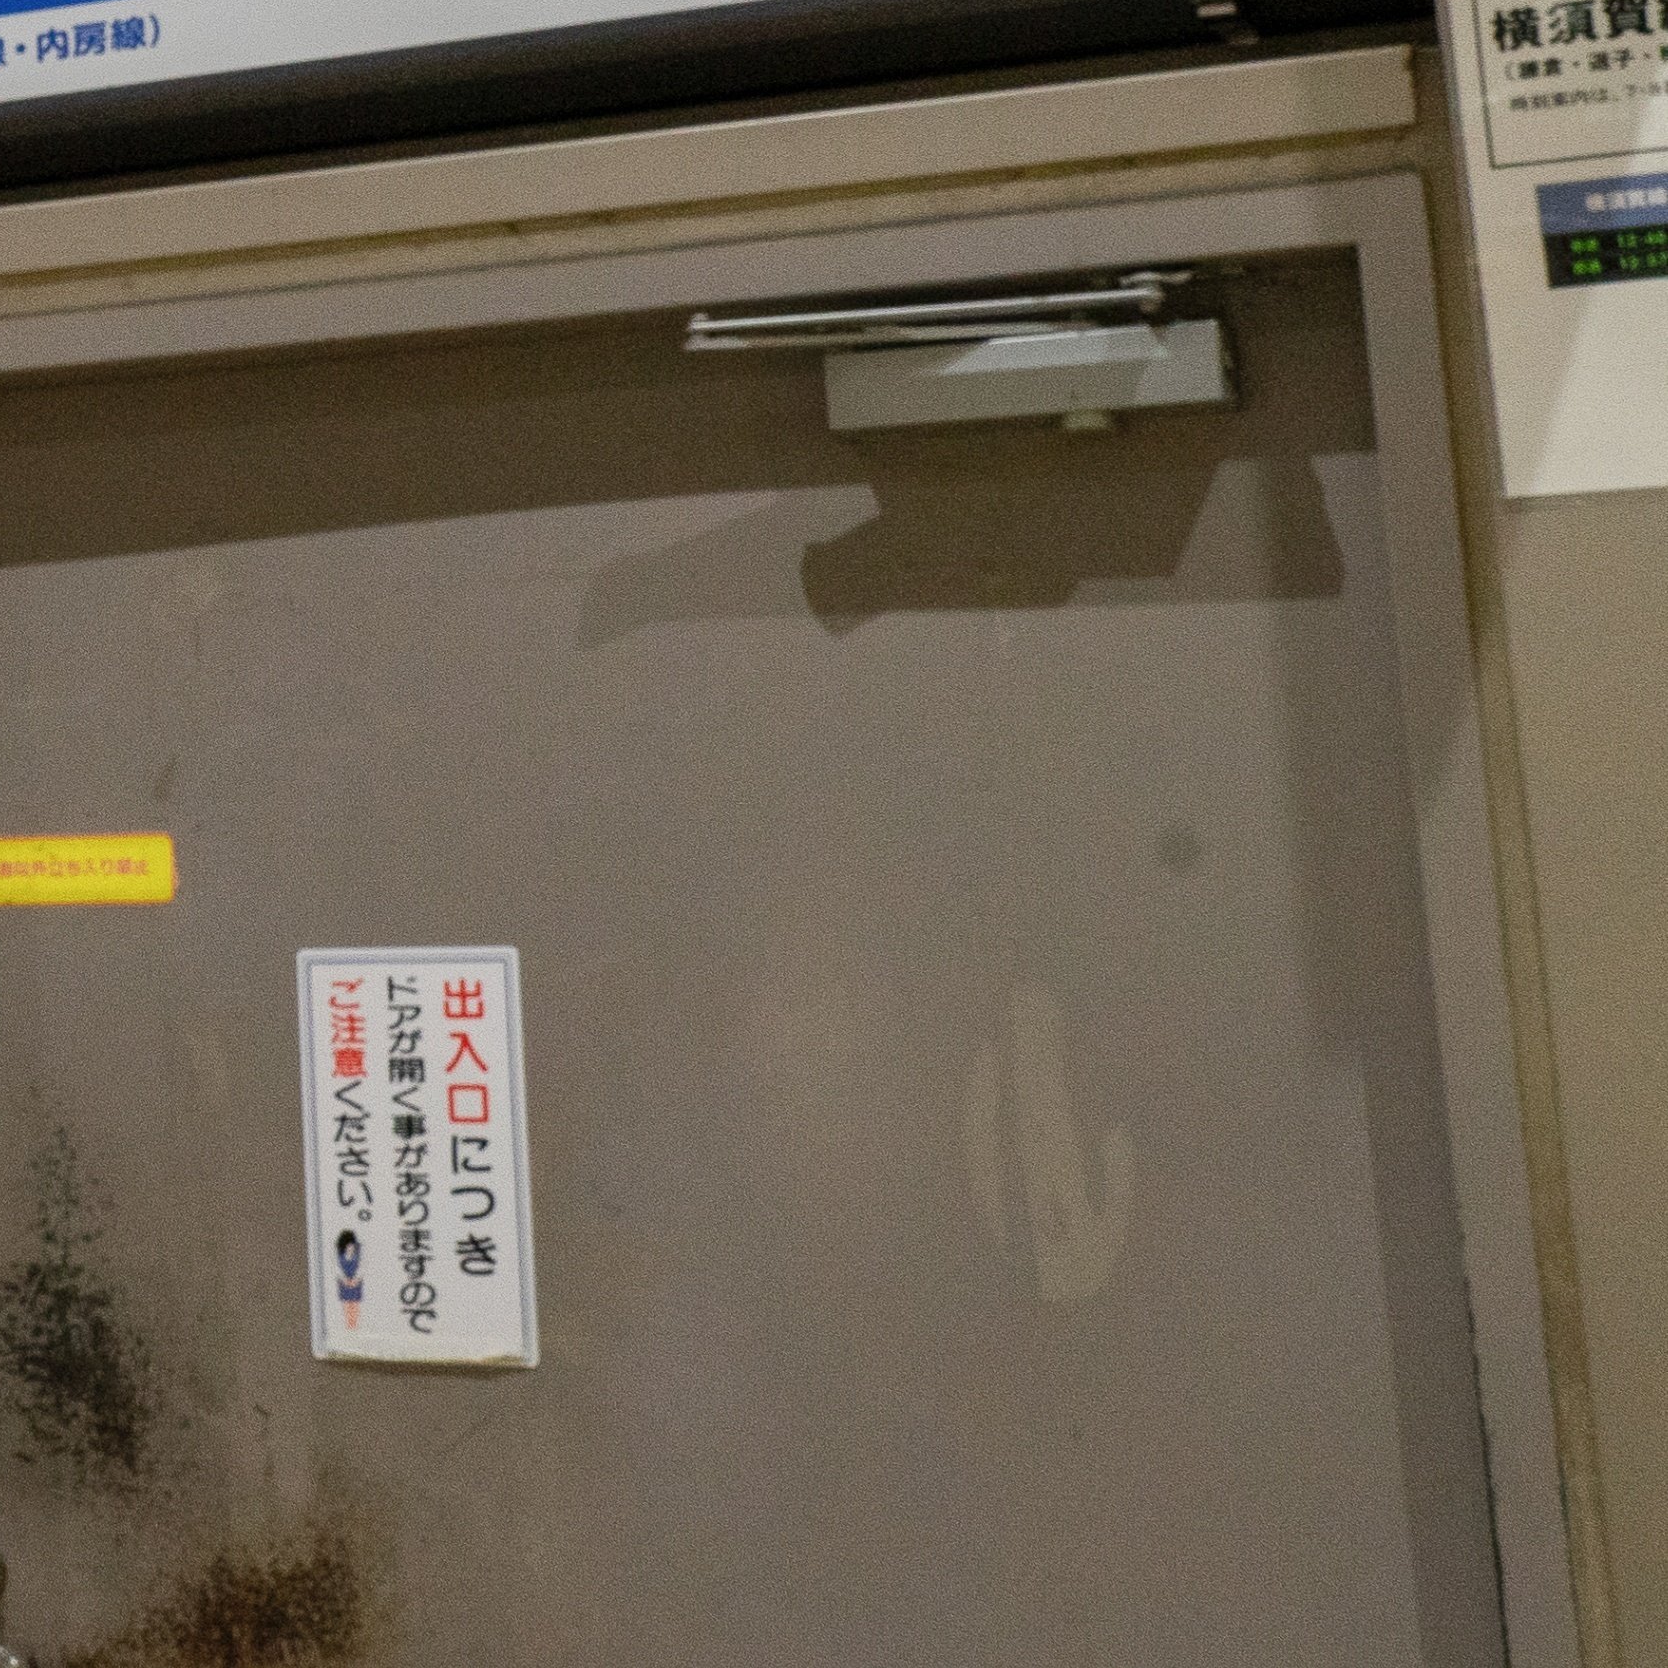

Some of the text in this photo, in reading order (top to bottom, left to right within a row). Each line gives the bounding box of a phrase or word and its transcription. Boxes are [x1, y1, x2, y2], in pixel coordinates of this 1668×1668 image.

[441, 977, 498, 1278] 出入口につき
